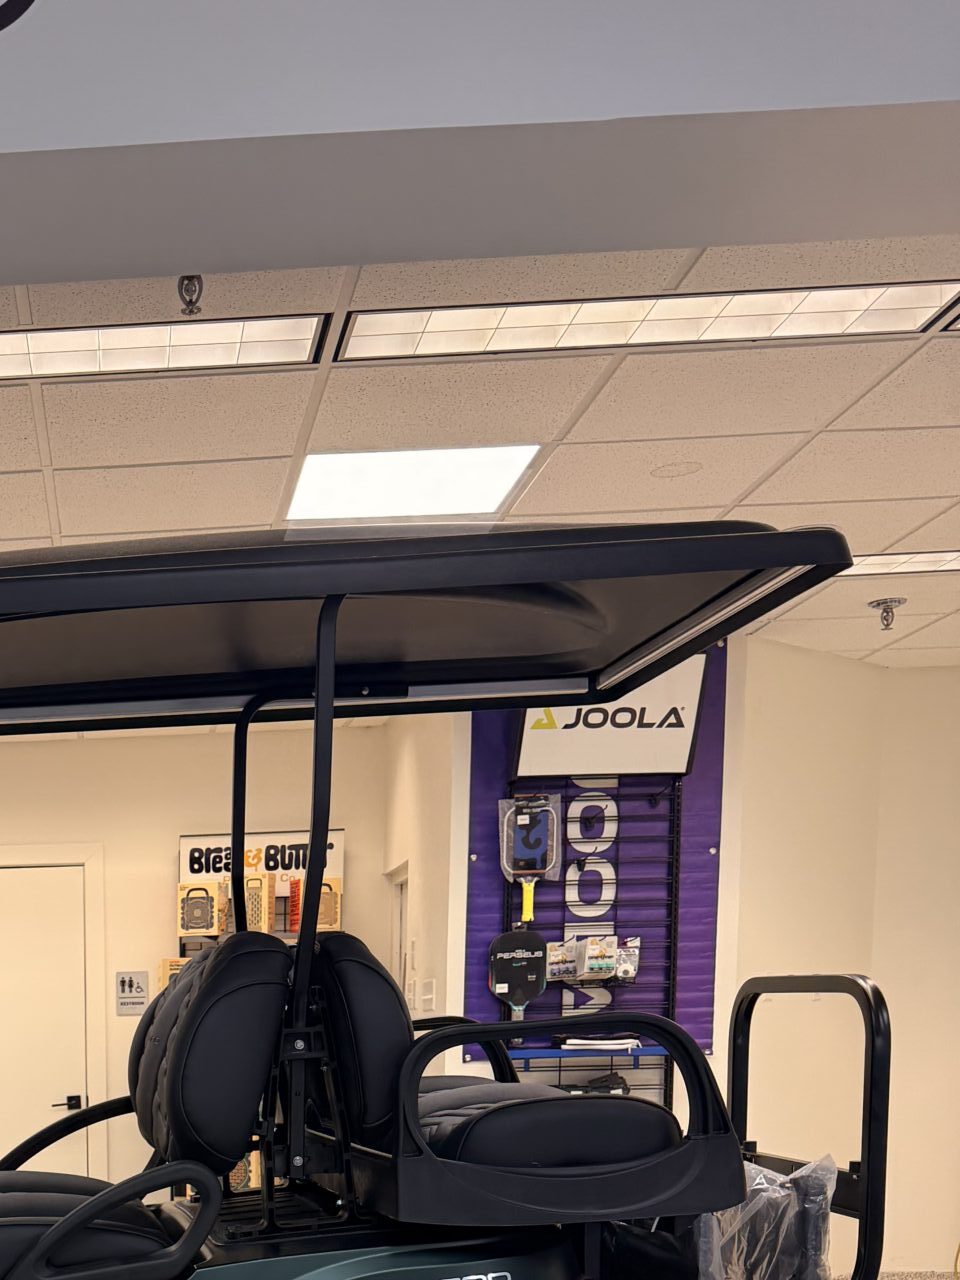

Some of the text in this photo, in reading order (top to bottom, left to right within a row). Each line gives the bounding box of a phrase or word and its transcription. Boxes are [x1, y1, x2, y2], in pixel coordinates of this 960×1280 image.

[561, 706, 685, 730] JOOLA
[189, 846, 232, 875] Brea
[561, 776, 619, 1017] OOLA
